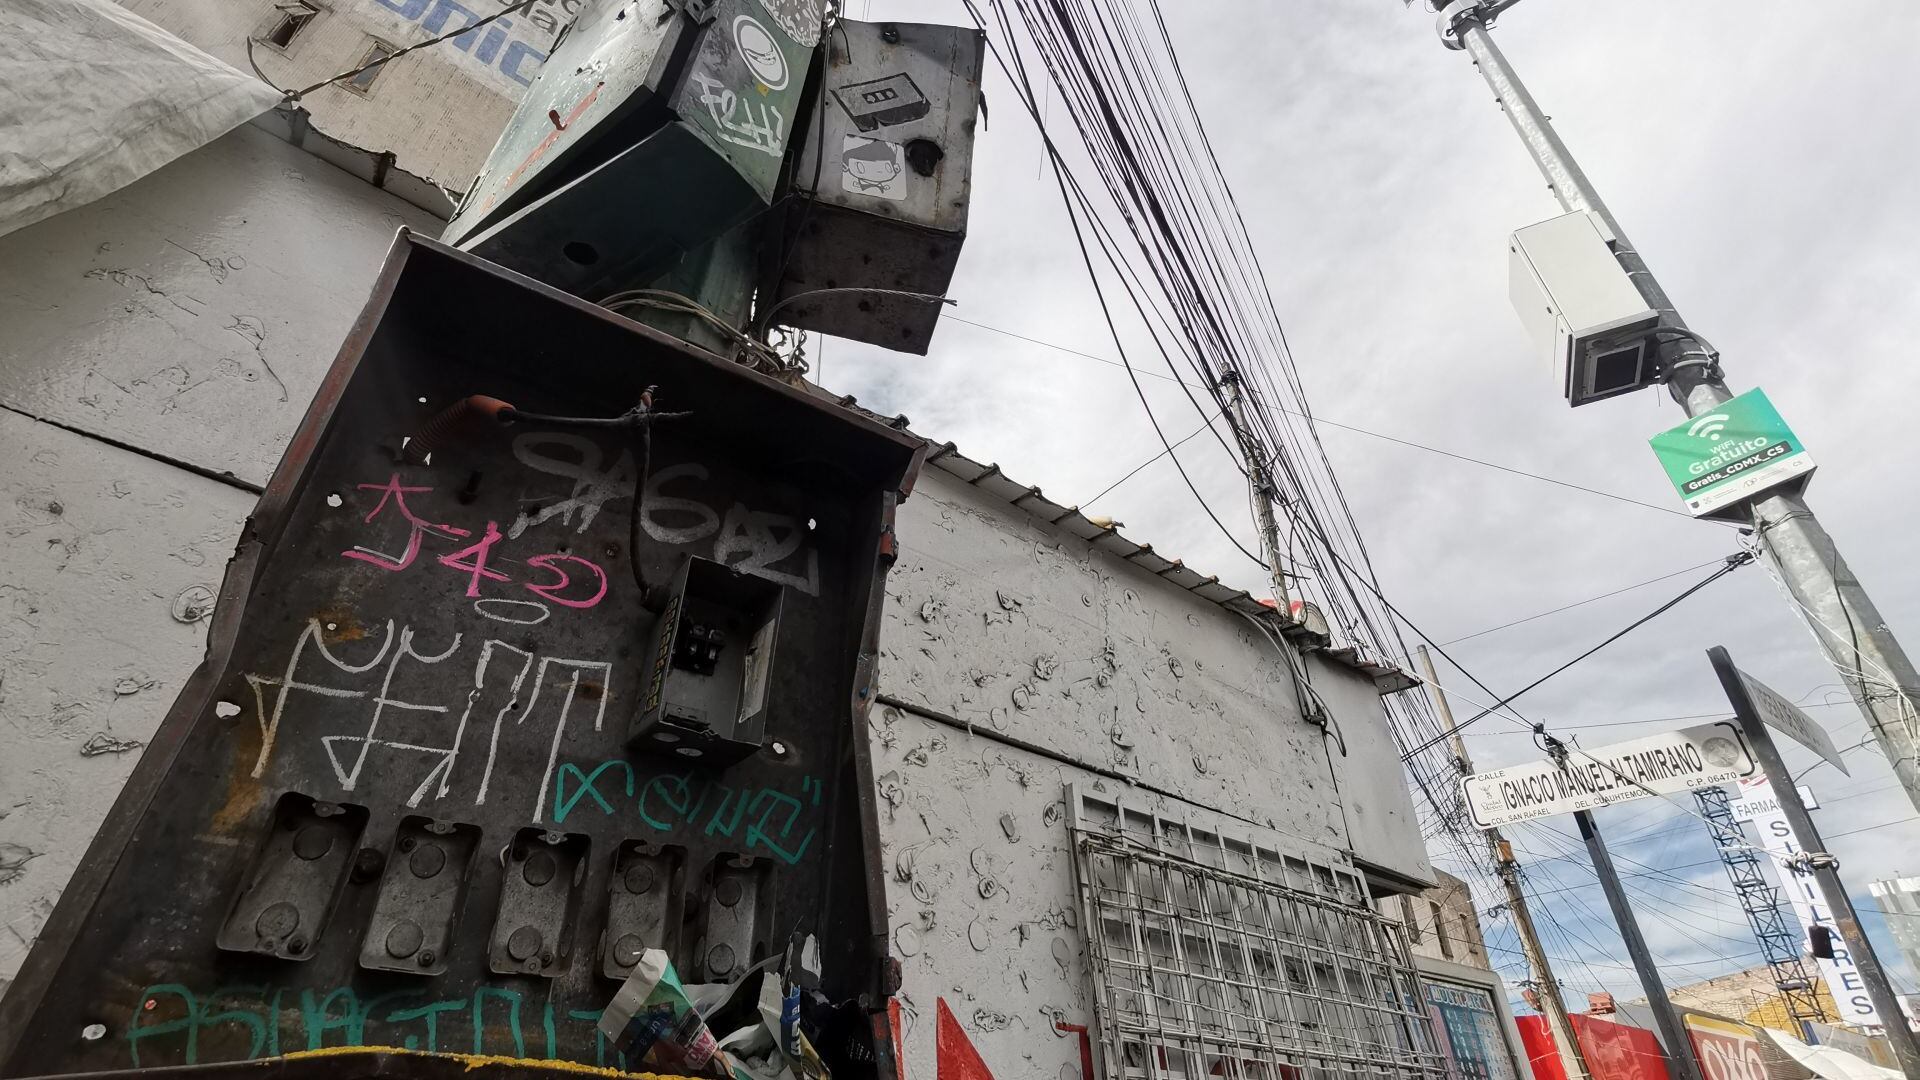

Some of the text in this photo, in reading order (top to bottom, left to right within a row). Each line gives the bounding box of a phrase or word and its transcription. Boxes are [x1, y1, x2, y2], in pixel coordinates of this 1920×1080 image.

[1688, 436, 1768, 476] Gratuito
[1688, 445, 1785, 491] Gratis_CDMX_C5
[1478, 770, 1506, 782] CALLE
[1498, 742, 1703, 810] IGNACIO MANUEL ALTAMIRANO
[1708, 772, 1737, 784] 06470
[1508, 814, 1523, 822] SAN
[1523, 808, 1551, 819] RAFAEL
